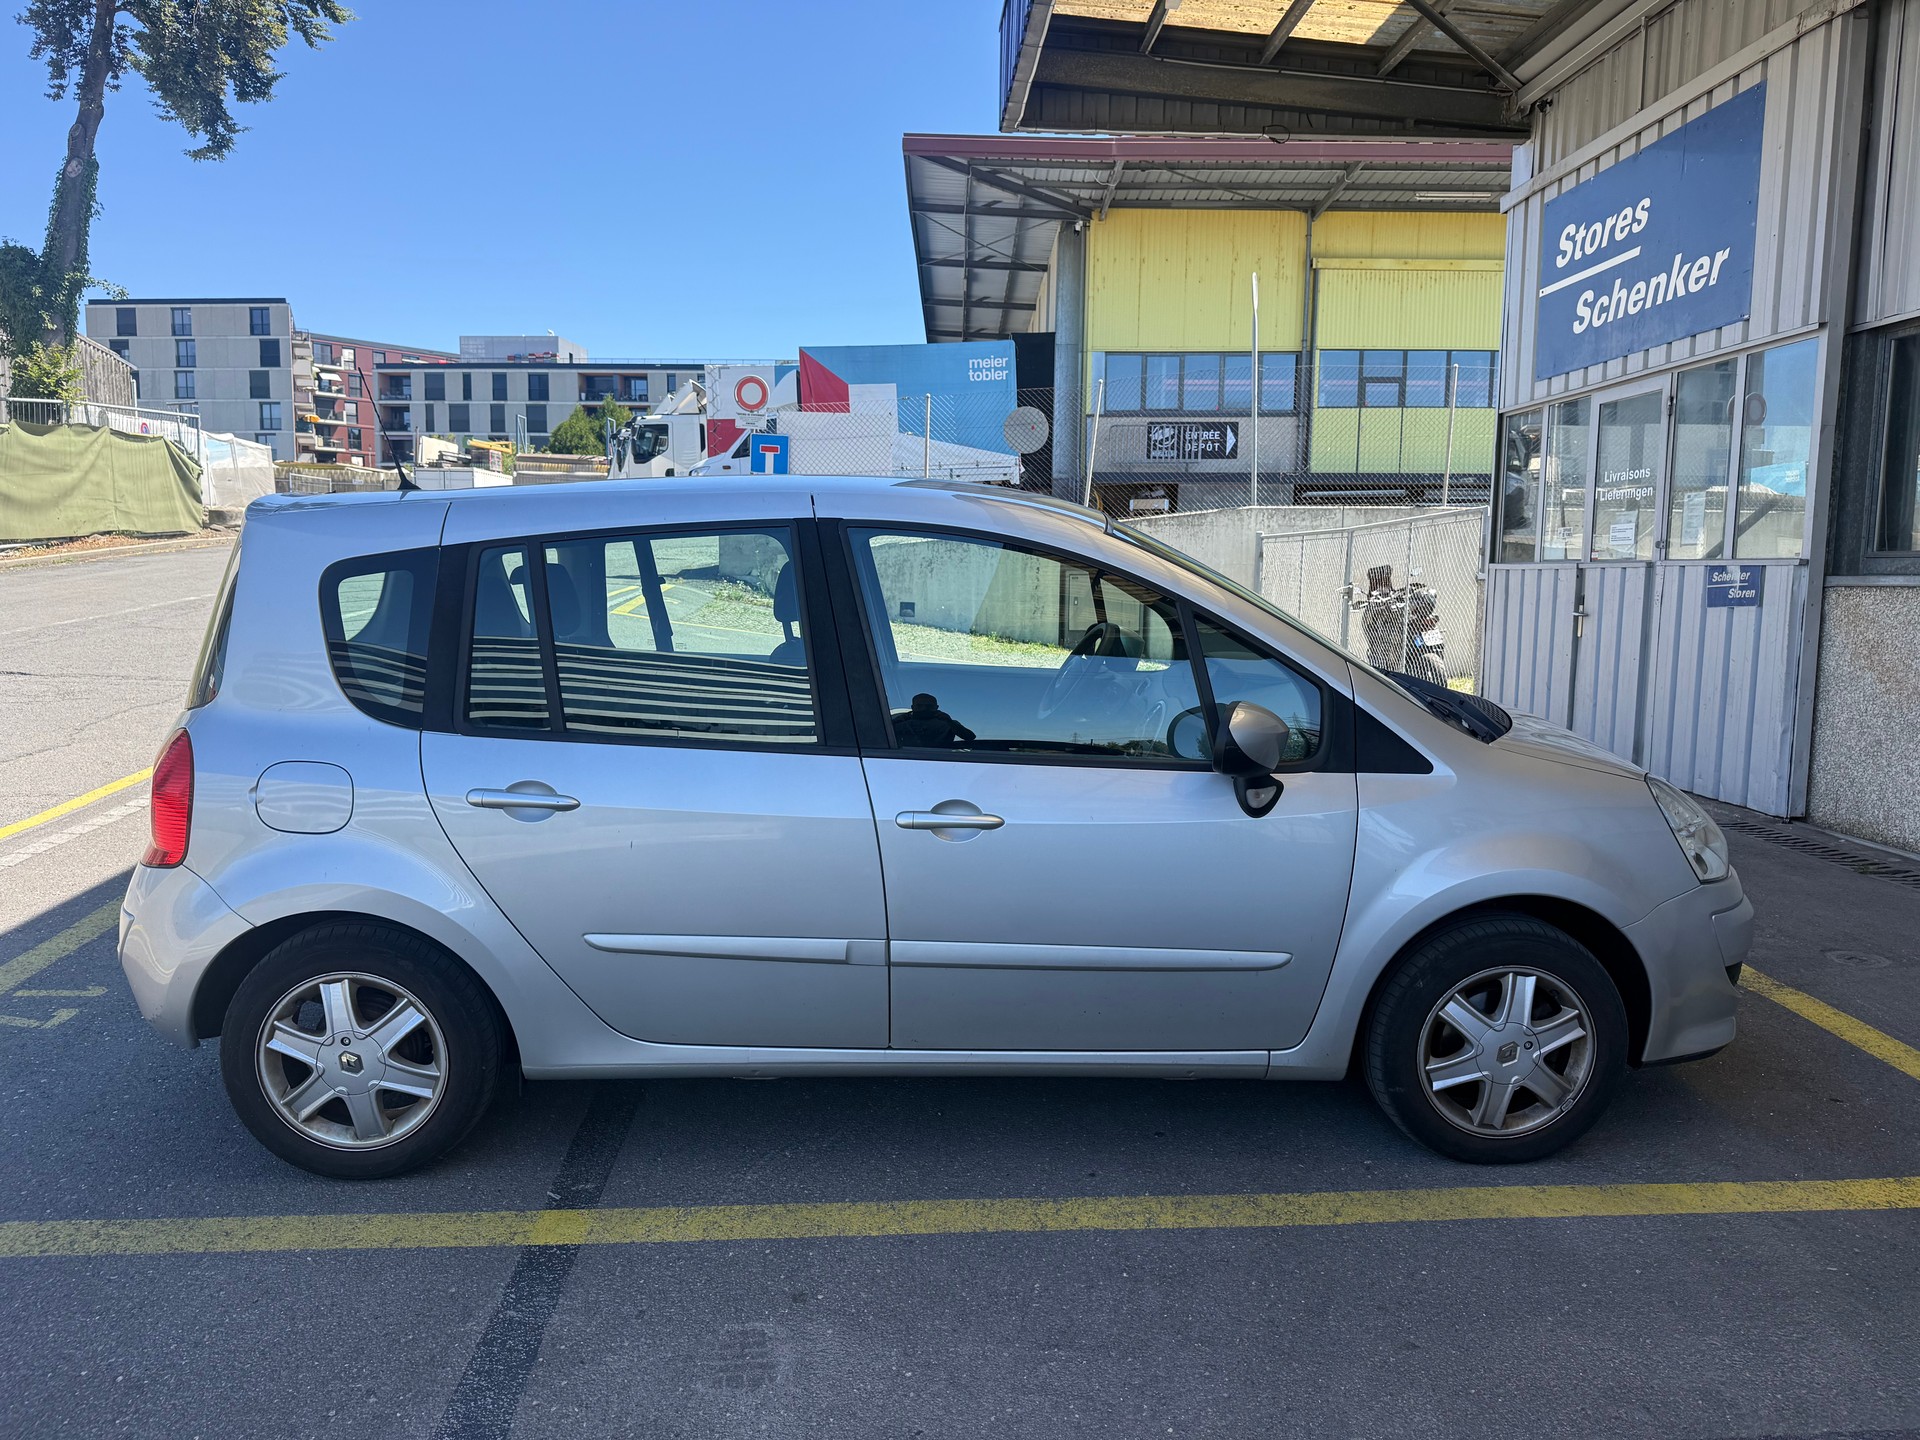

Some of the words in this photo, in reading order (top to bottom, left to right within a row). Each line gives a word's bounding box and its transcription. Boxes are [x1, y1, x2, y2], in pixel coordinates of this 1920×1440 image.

[1555, 197, 1651, 269] Stores
[1572, 247, 1731, 335] Schenker
[969, 355, 1008, 368] meier
[968, 369, 1008, 381] tobler
[1604, 468, 1651, 482] Livraisons
[1600, 486, 1653, 501] Lieferungen
[1712, 571, 1750, 582] Scheer
